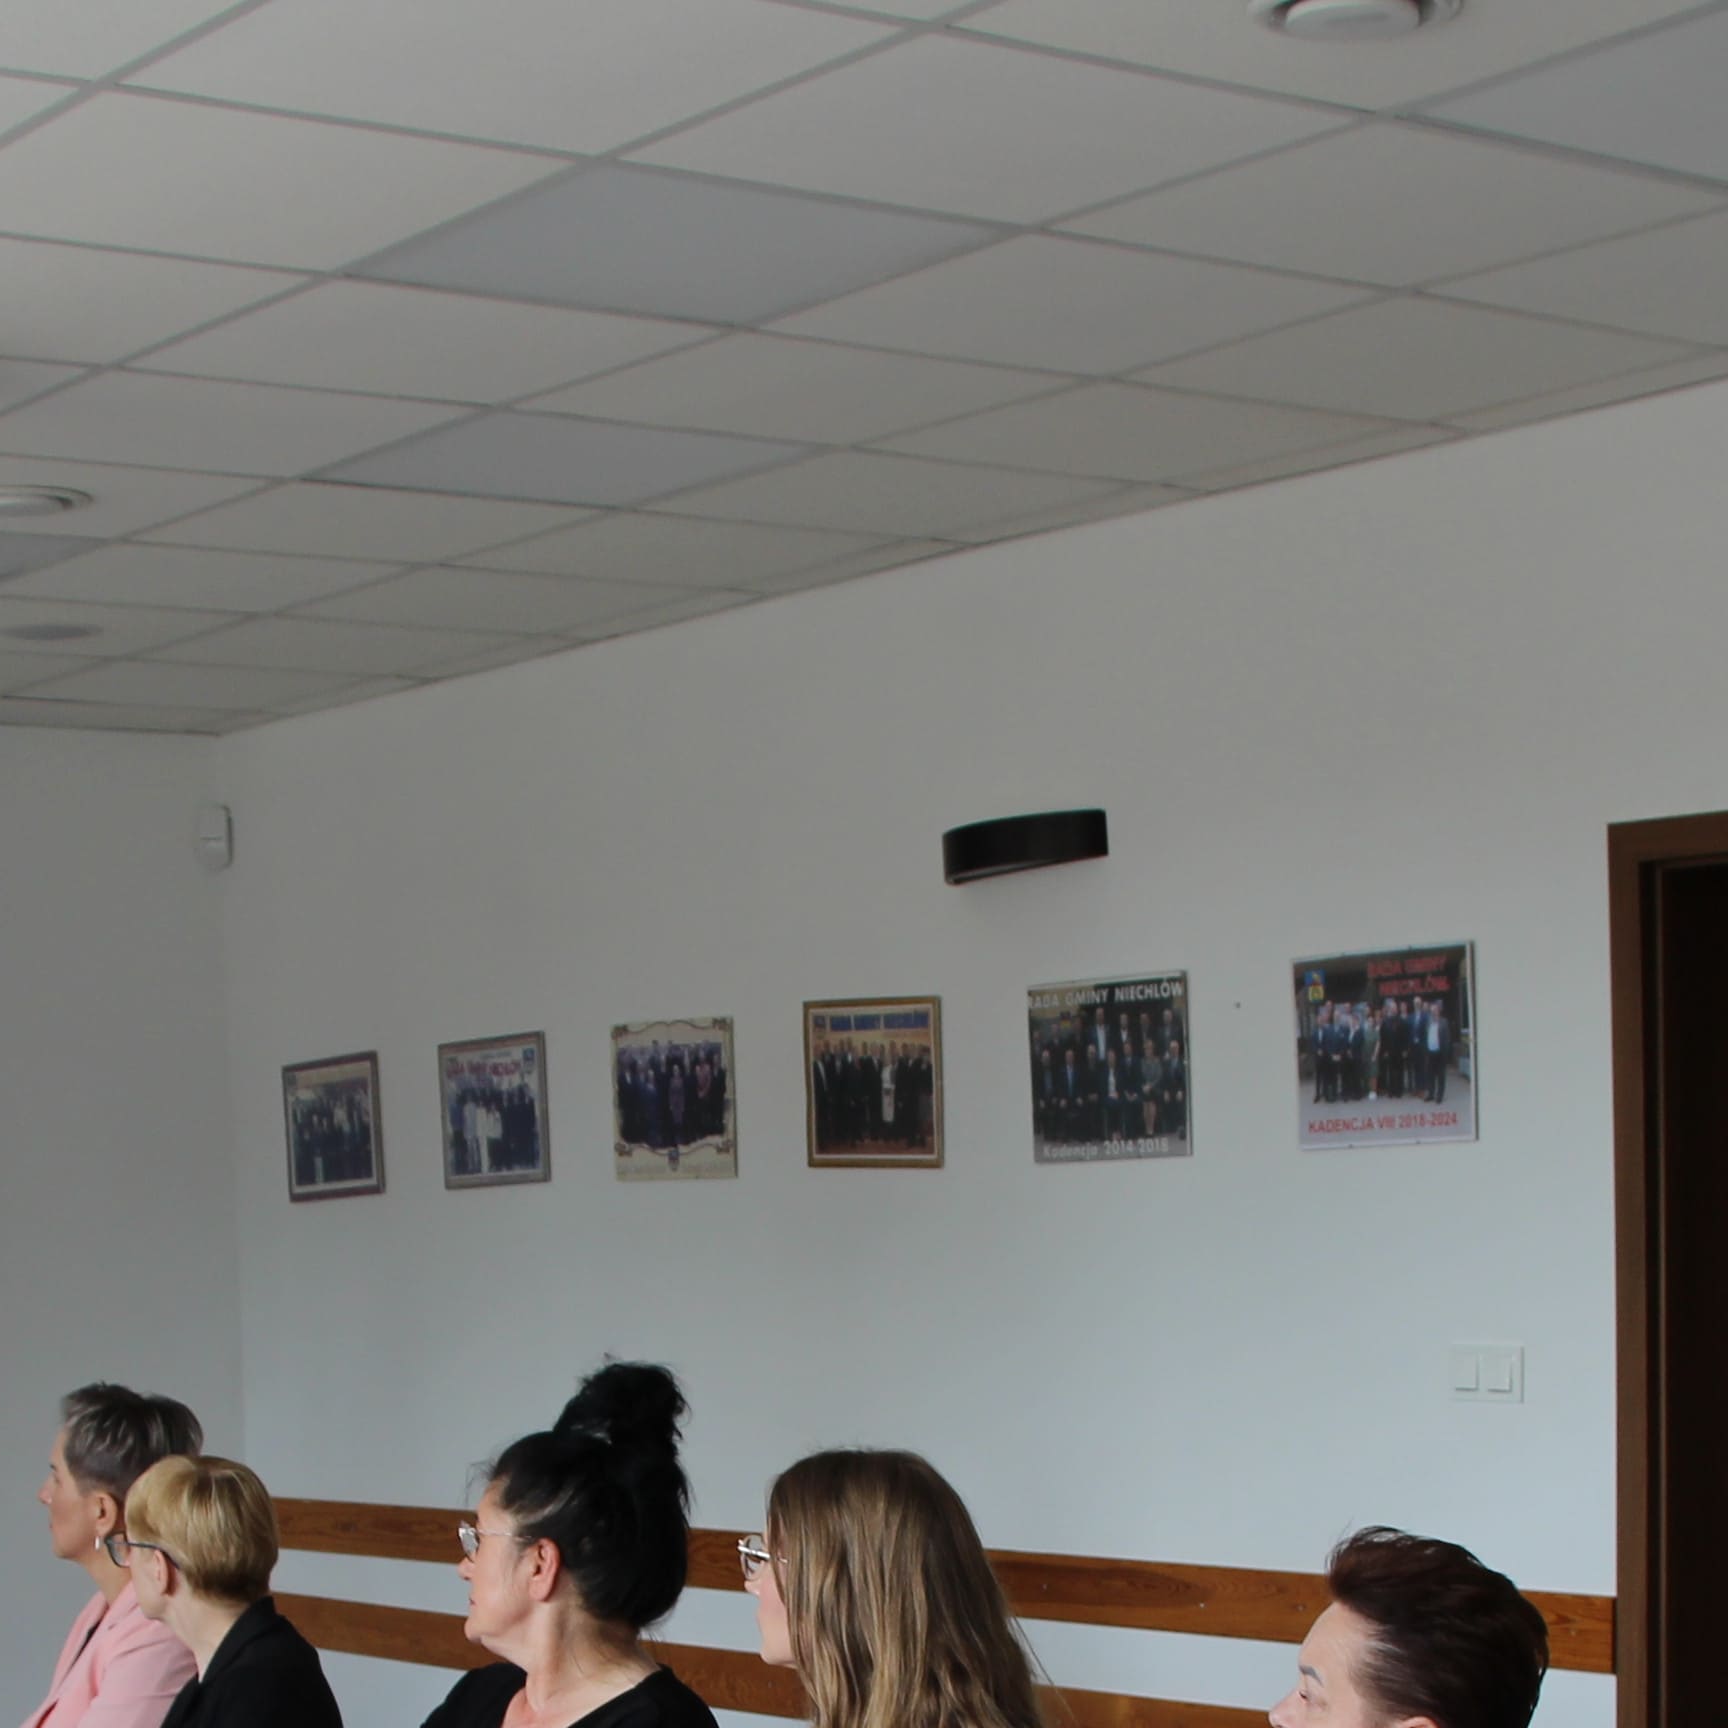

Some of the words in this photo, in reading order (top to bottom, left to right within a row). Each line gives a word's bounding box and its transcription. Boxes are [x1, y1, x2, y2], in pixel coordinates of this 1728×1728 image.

[1065, 987, 1109, 1006] GMINY
[1115, 979, 1183, 1003] NIECHLÓW
[1308, 1117, 1374, 1133] KADENCJA
